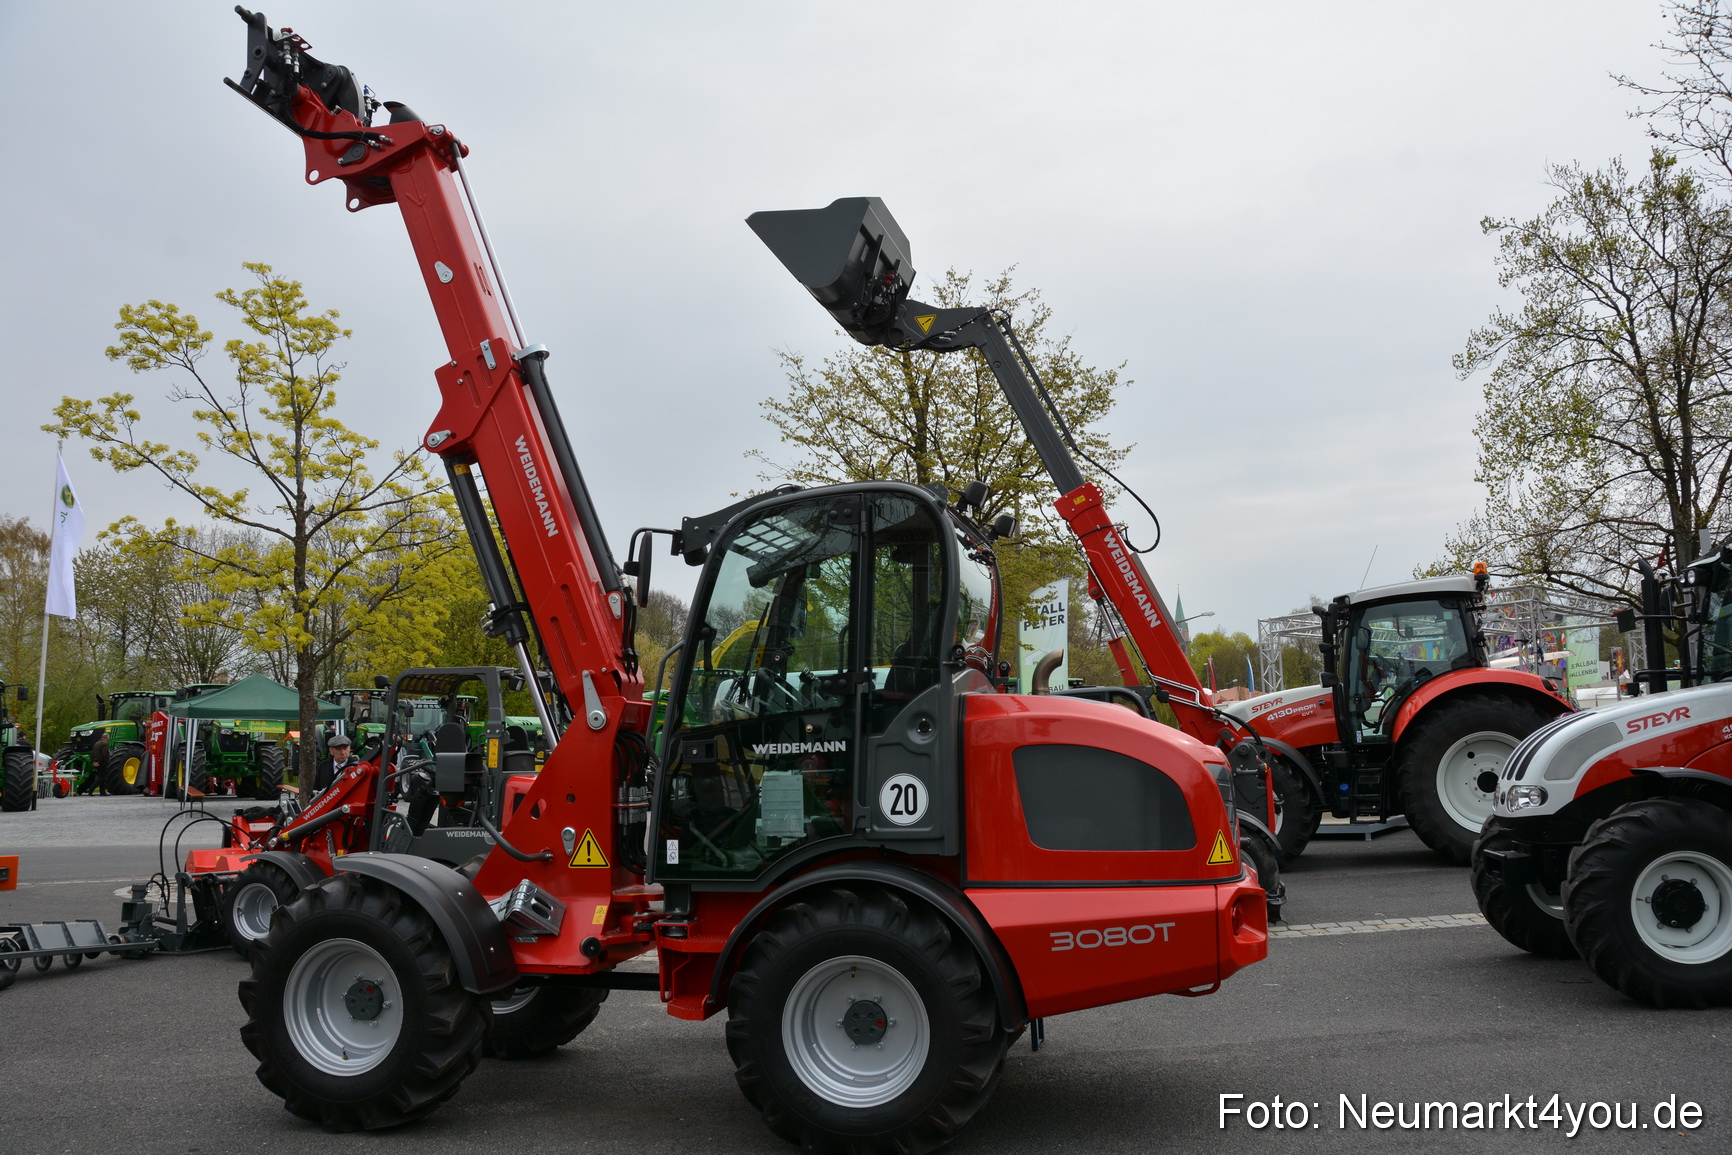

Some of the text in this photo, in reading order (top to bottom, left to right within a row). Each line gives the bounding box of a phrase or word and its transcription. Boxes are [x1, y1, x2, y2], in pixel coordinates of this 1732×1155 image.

[515, 434, 559, 537] WEIDEMANN
[1103, 531, 1161, 628] WEIDEMANN
[1023, 614, 1066, 631] PETER
[1251, 698, 1283, 713] STEYR
[1267, 707, 1293, 721] 4130
[1626, 706, 1691, 734] STEYR
[752, 740, 847, 755] WEIDEMANN
[302, 787, 341, 821] WEIDEMANN
[889, 783, 918, 816] 20
[1050, 922, 1176, 951] 3080T
